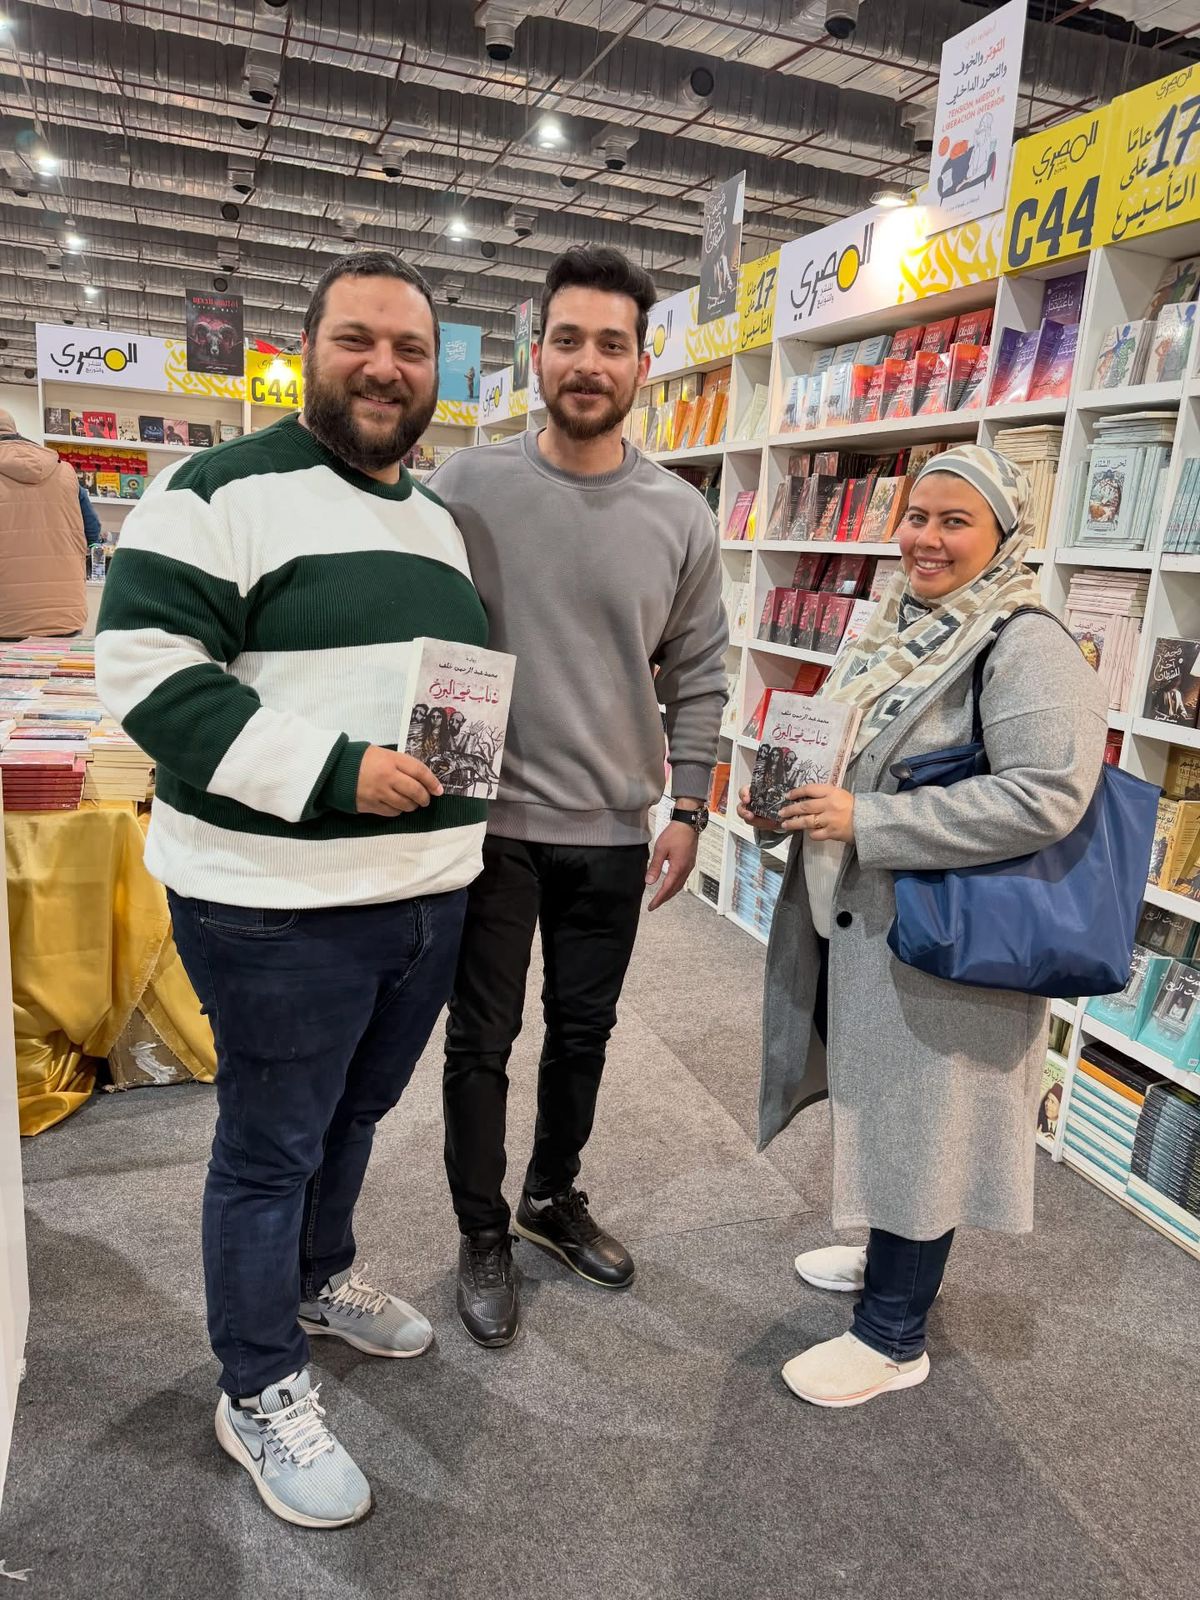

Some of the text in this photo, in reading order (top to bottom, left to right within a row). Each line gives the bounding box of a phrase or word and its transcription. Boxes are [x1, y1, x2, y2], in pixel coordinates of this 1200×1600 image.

[953, 50, 984, 76] والخوف
[979, 61, 1007, 89] والتحرر
[1156, 66, 1193, 100] المصري
[977, 95, 1005, 114] INTERIOR
[1032, 120, 1099, 184] المصري
[1147, 94, 1200, 177] 17
[1120, 155, 1149, 190] على
[1008, 175, 1100, 268] C44
[1111, 169, 1197, 241] التأسيس
[791, 222, 875, 321] المصري
[754, 266, 777, 312] 17
[50, 342, 138, 375] المصري
[251, 377, 299, 404] C44
[454, 666, 473, 674] الرحمن
[429, 678, 455, 699] البرزخ
[452, 685, 471, 702] في
